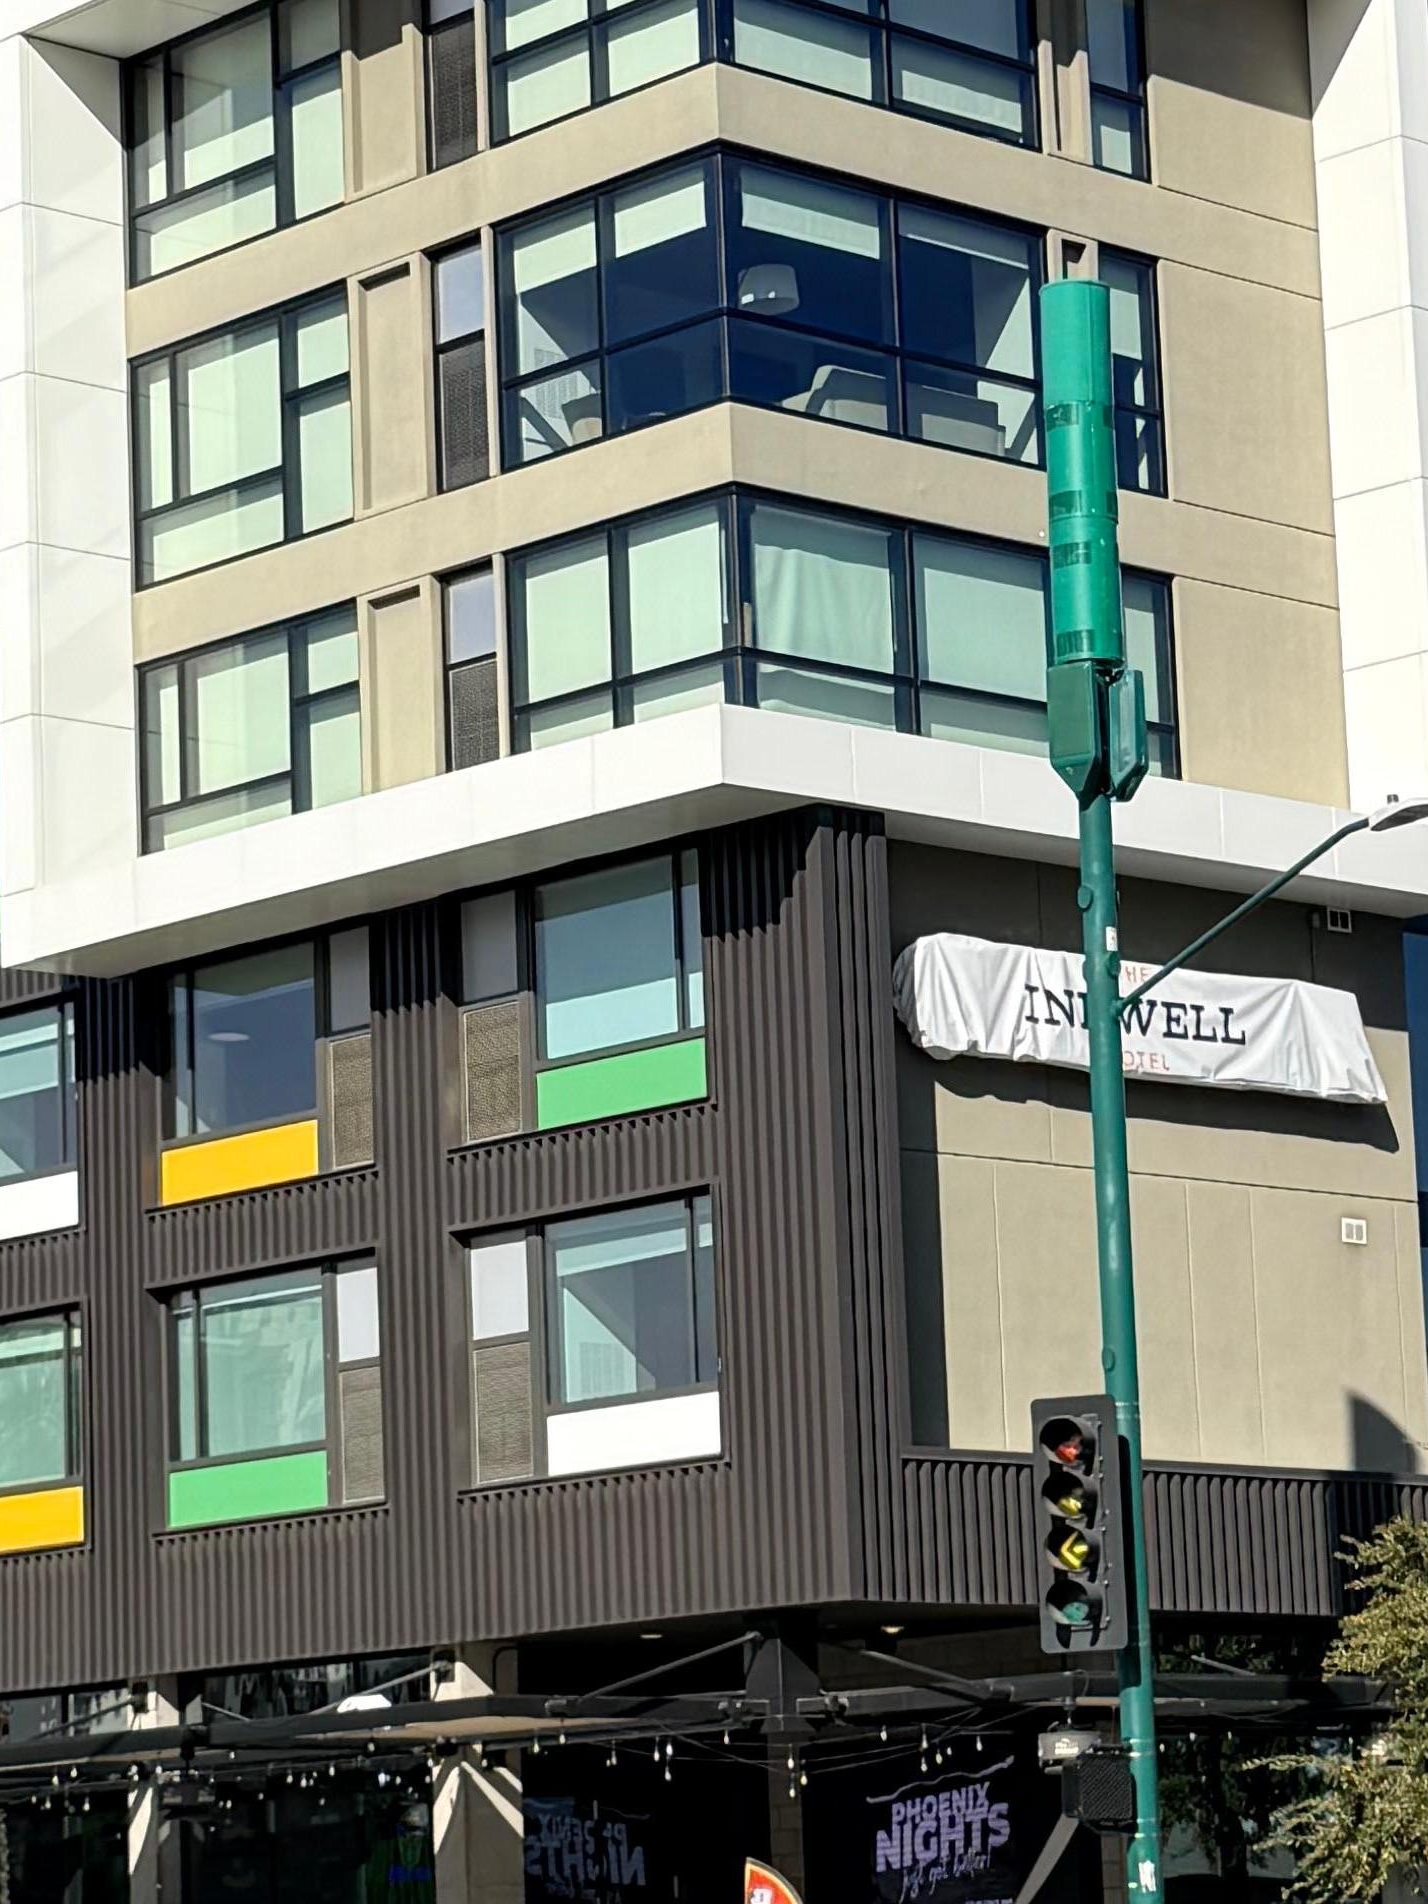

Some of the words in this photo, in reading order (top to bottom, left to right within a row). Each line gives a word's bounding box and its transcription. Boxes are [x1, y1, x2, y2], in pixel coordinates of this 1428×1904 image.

[1125, 965, 1150, 983] HE
[1122, 1050, 1170, 1072] OTEL
[892, 1781, 990, 1826] PHOENIX
[876, 1802, 1010, 1873] NIGHTS
